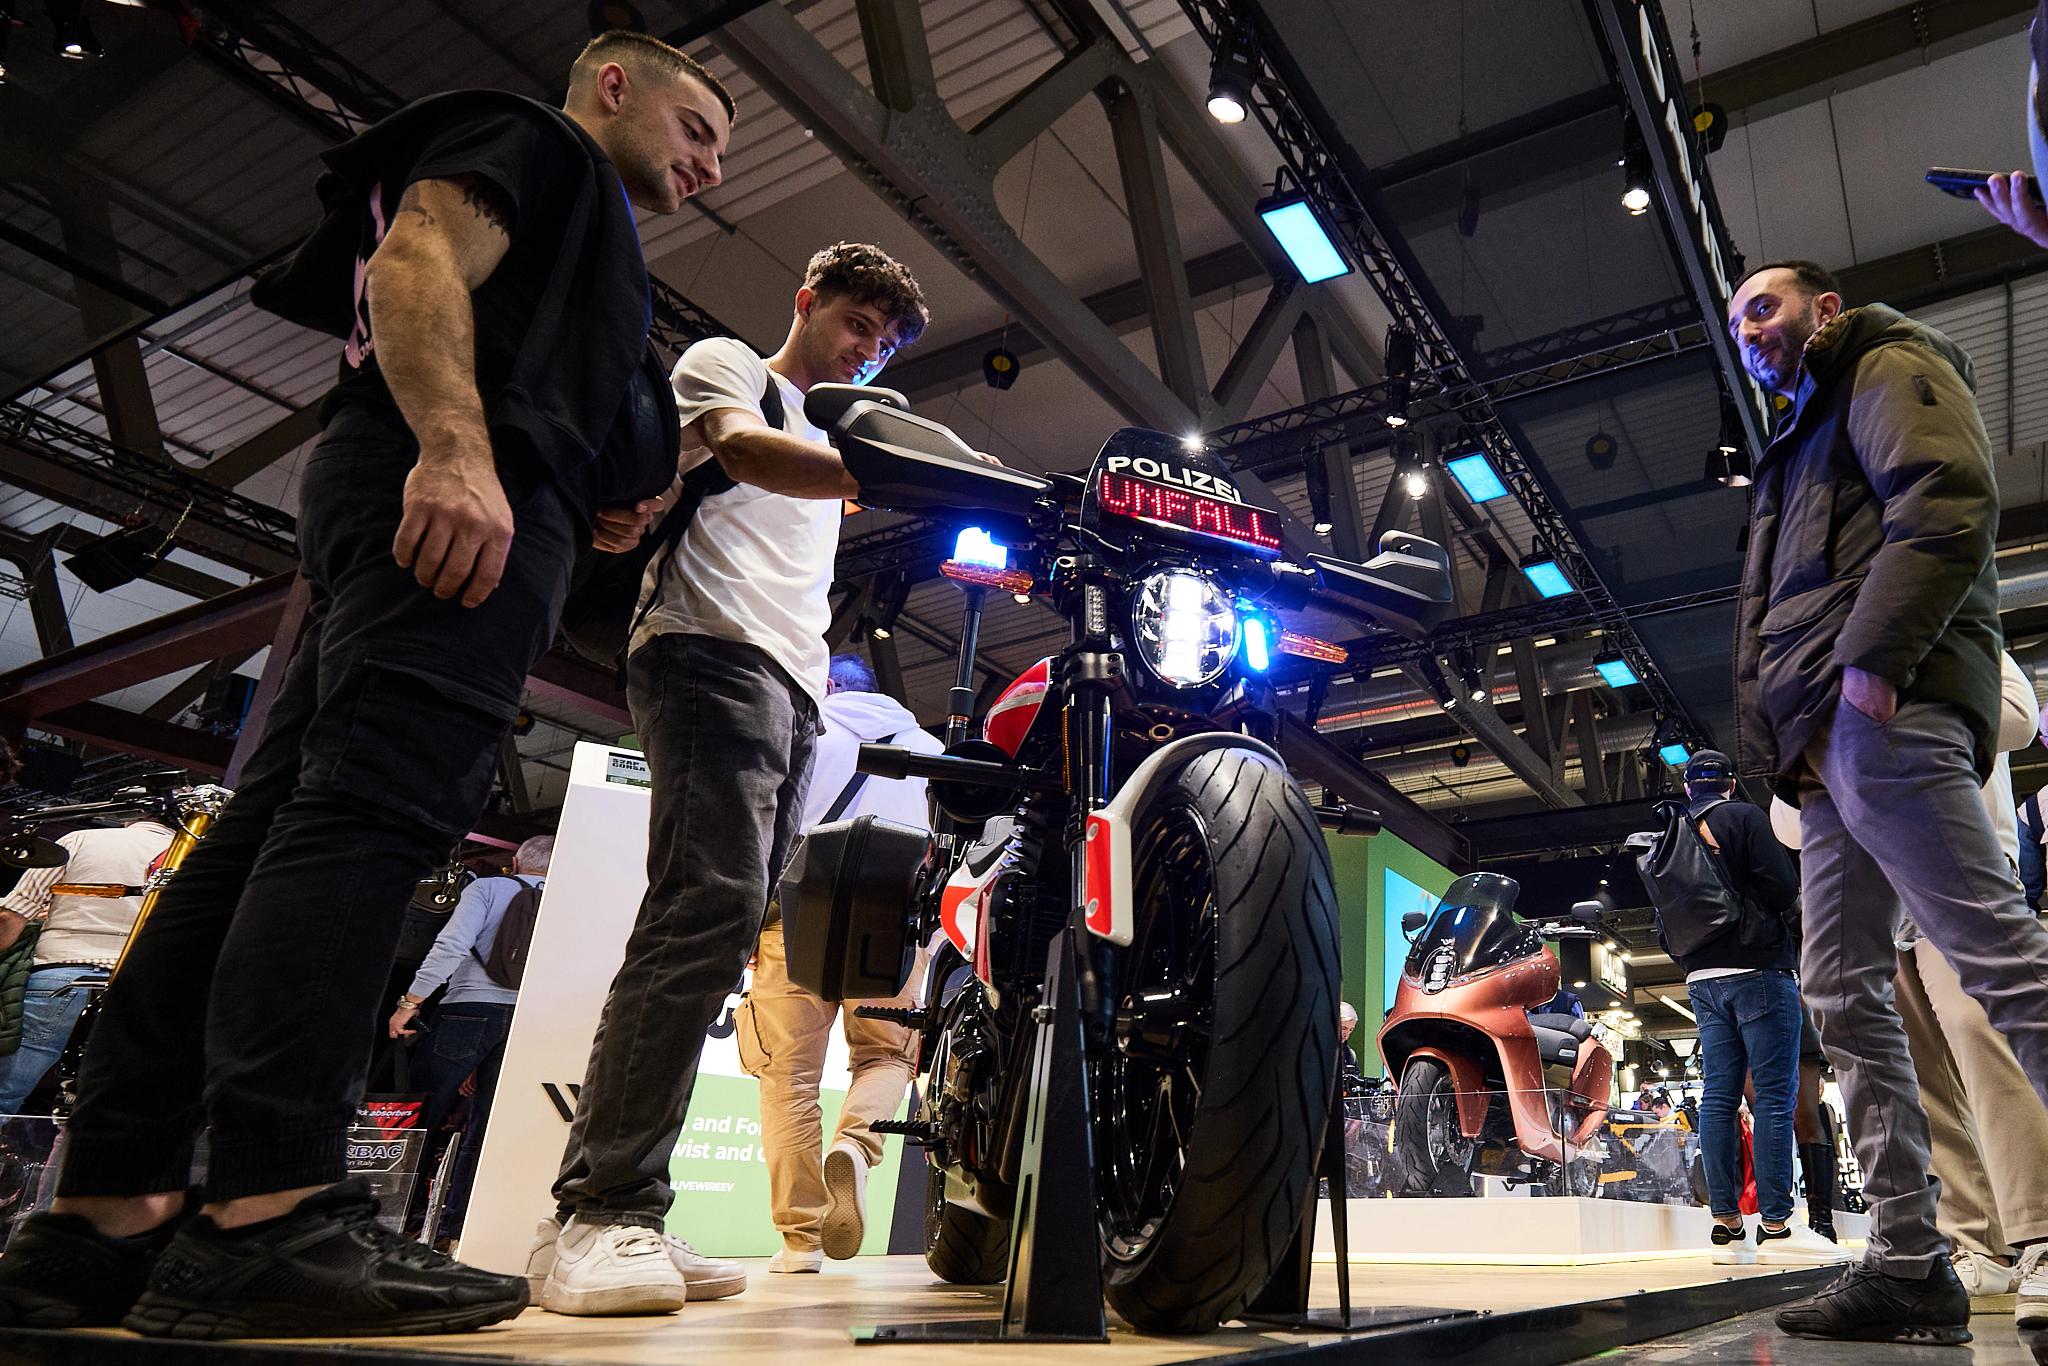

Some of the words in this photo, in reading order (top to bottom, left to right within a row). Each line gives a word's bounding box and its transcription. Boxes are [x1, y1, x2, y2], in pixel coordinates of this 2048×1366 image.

[1107, 456, 1242, 504] POLIZEI
[1102, 474, 1281, 546] UNFALL
[369, 1109, 414, 1117] absorbers
[692, 1115, 732, 1133] and
[671, 1138, 711, 1159] wist
[714, 1144, 754, 1161] and
[670, 1180, 735, 1192] LIVEWIREEV
